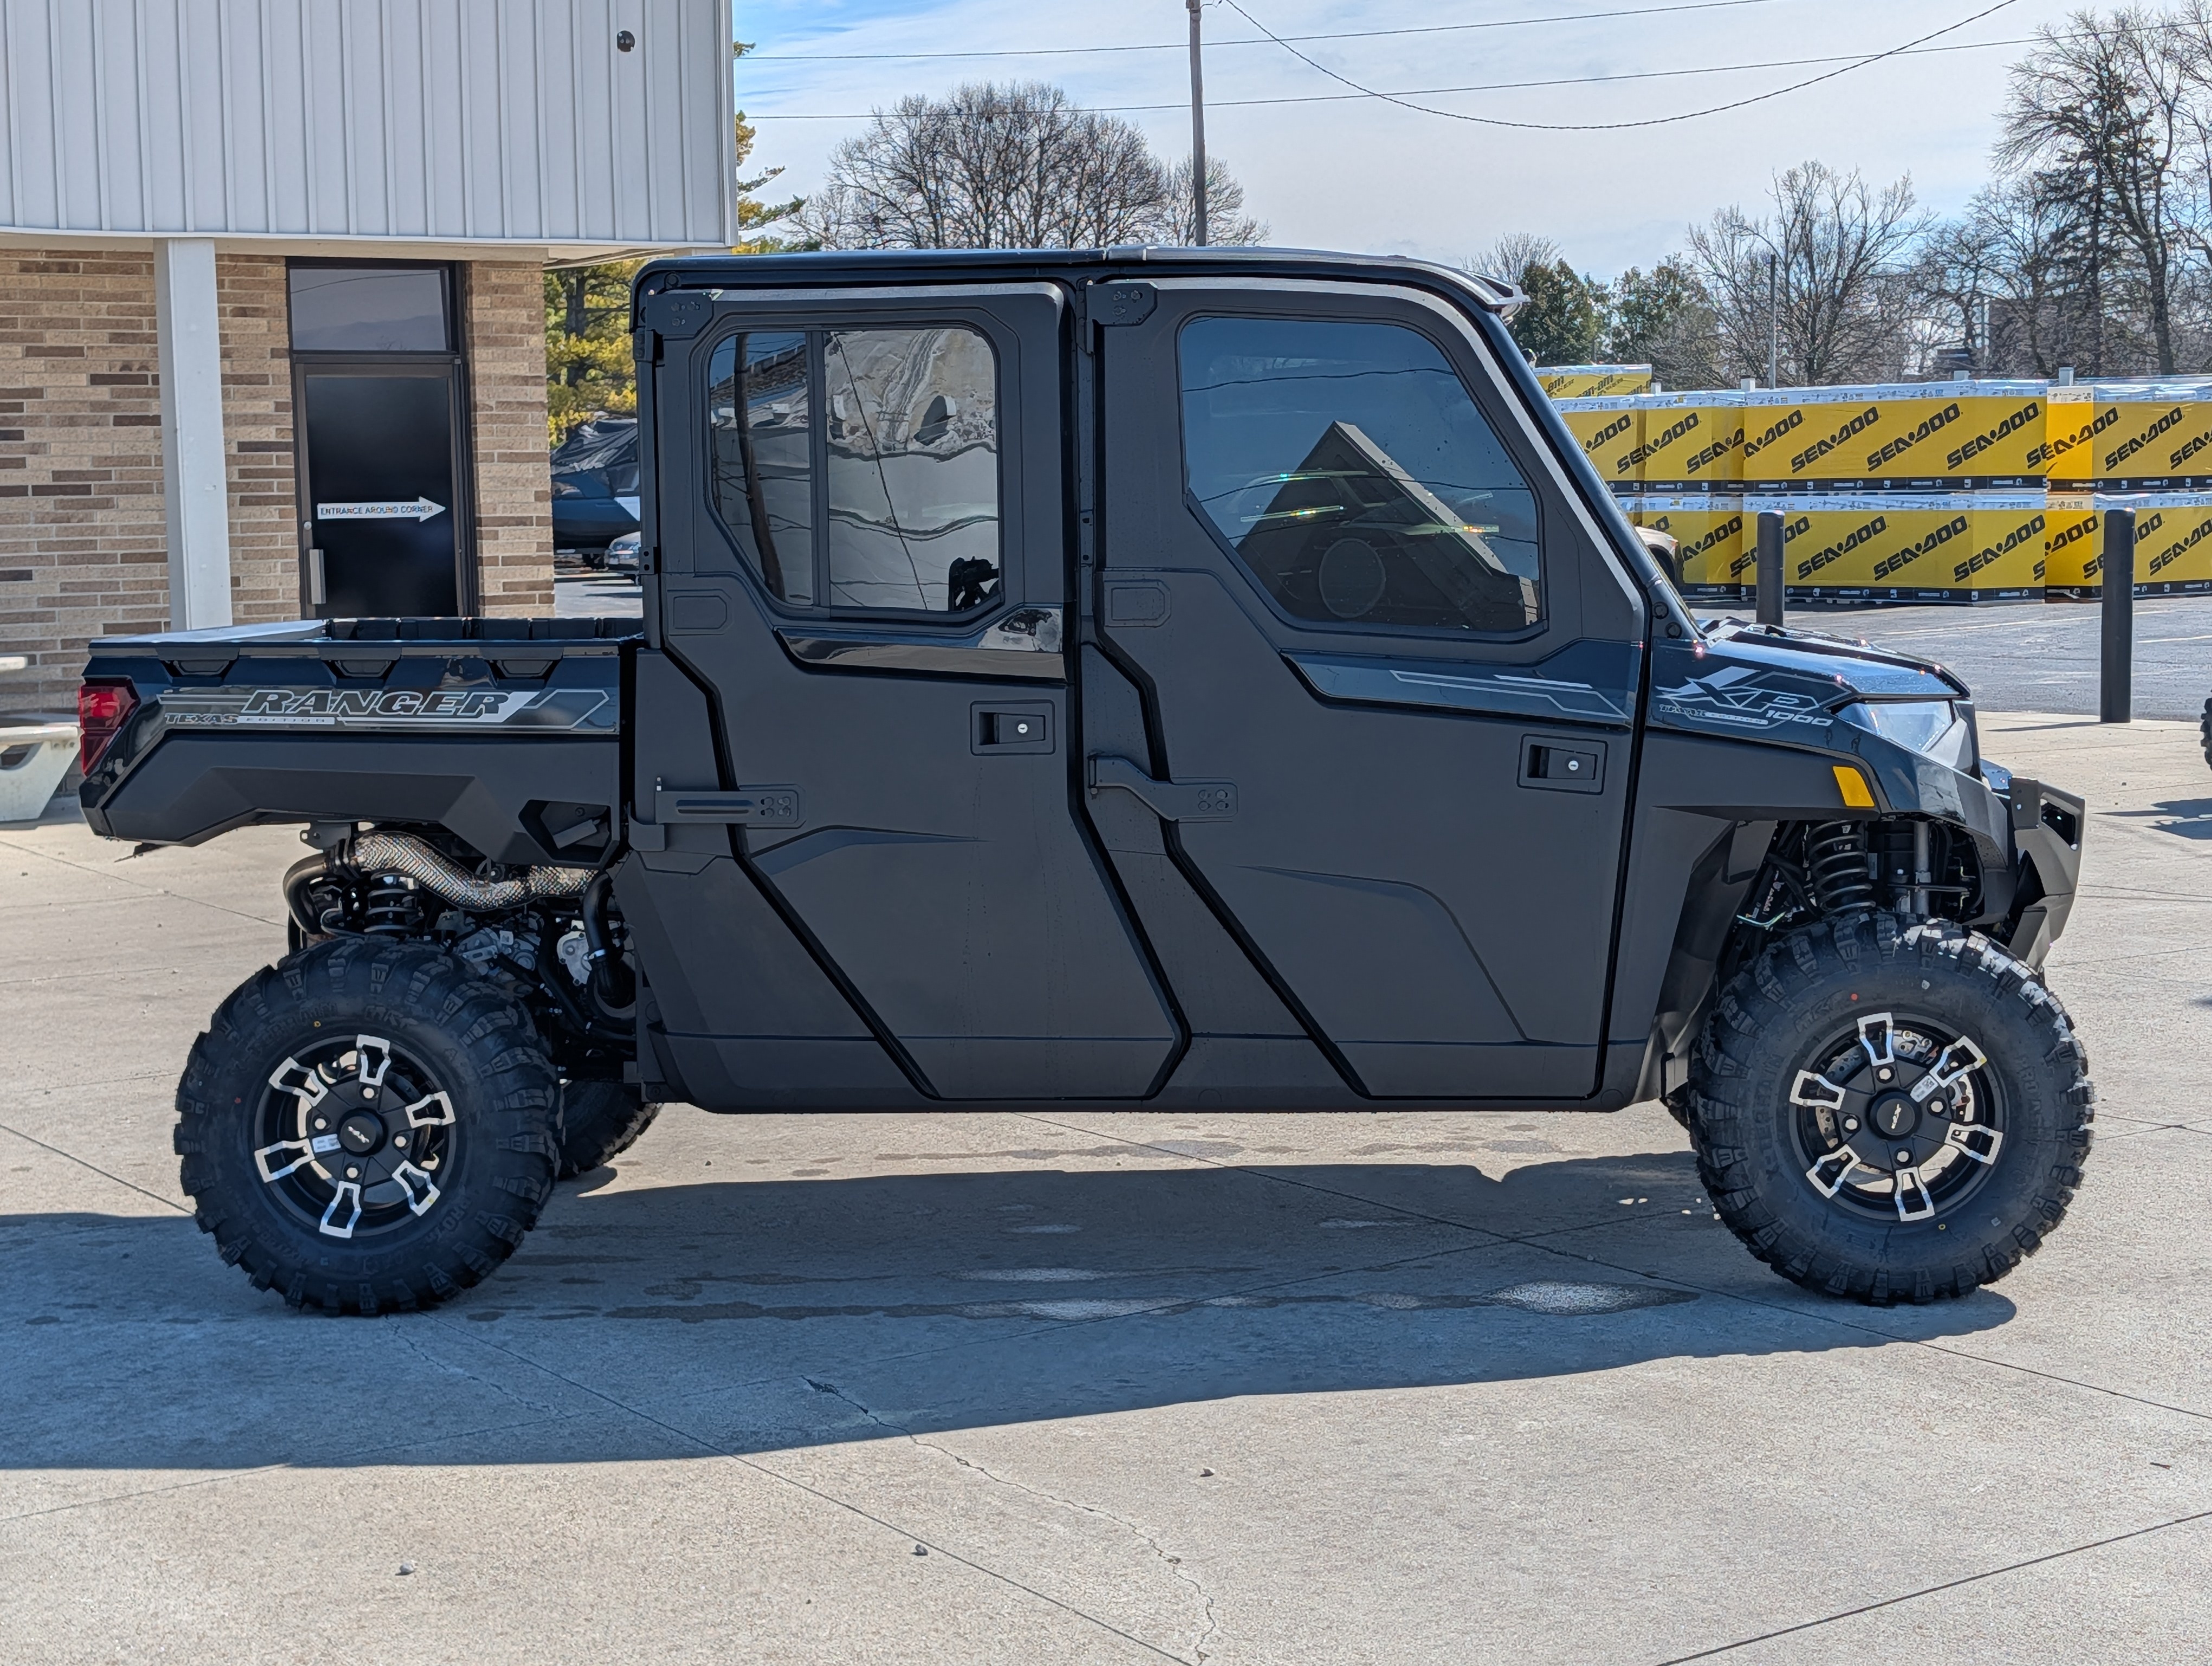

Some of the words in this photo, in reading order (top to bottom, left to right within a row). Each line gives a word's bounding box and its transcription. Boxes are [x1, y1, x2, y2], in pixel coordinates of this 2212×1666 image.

[240, 689, 511, 715] RANGER
[164, 713, 240, 725] TEXAS
[1765, 709, 1834, 727] 1000
